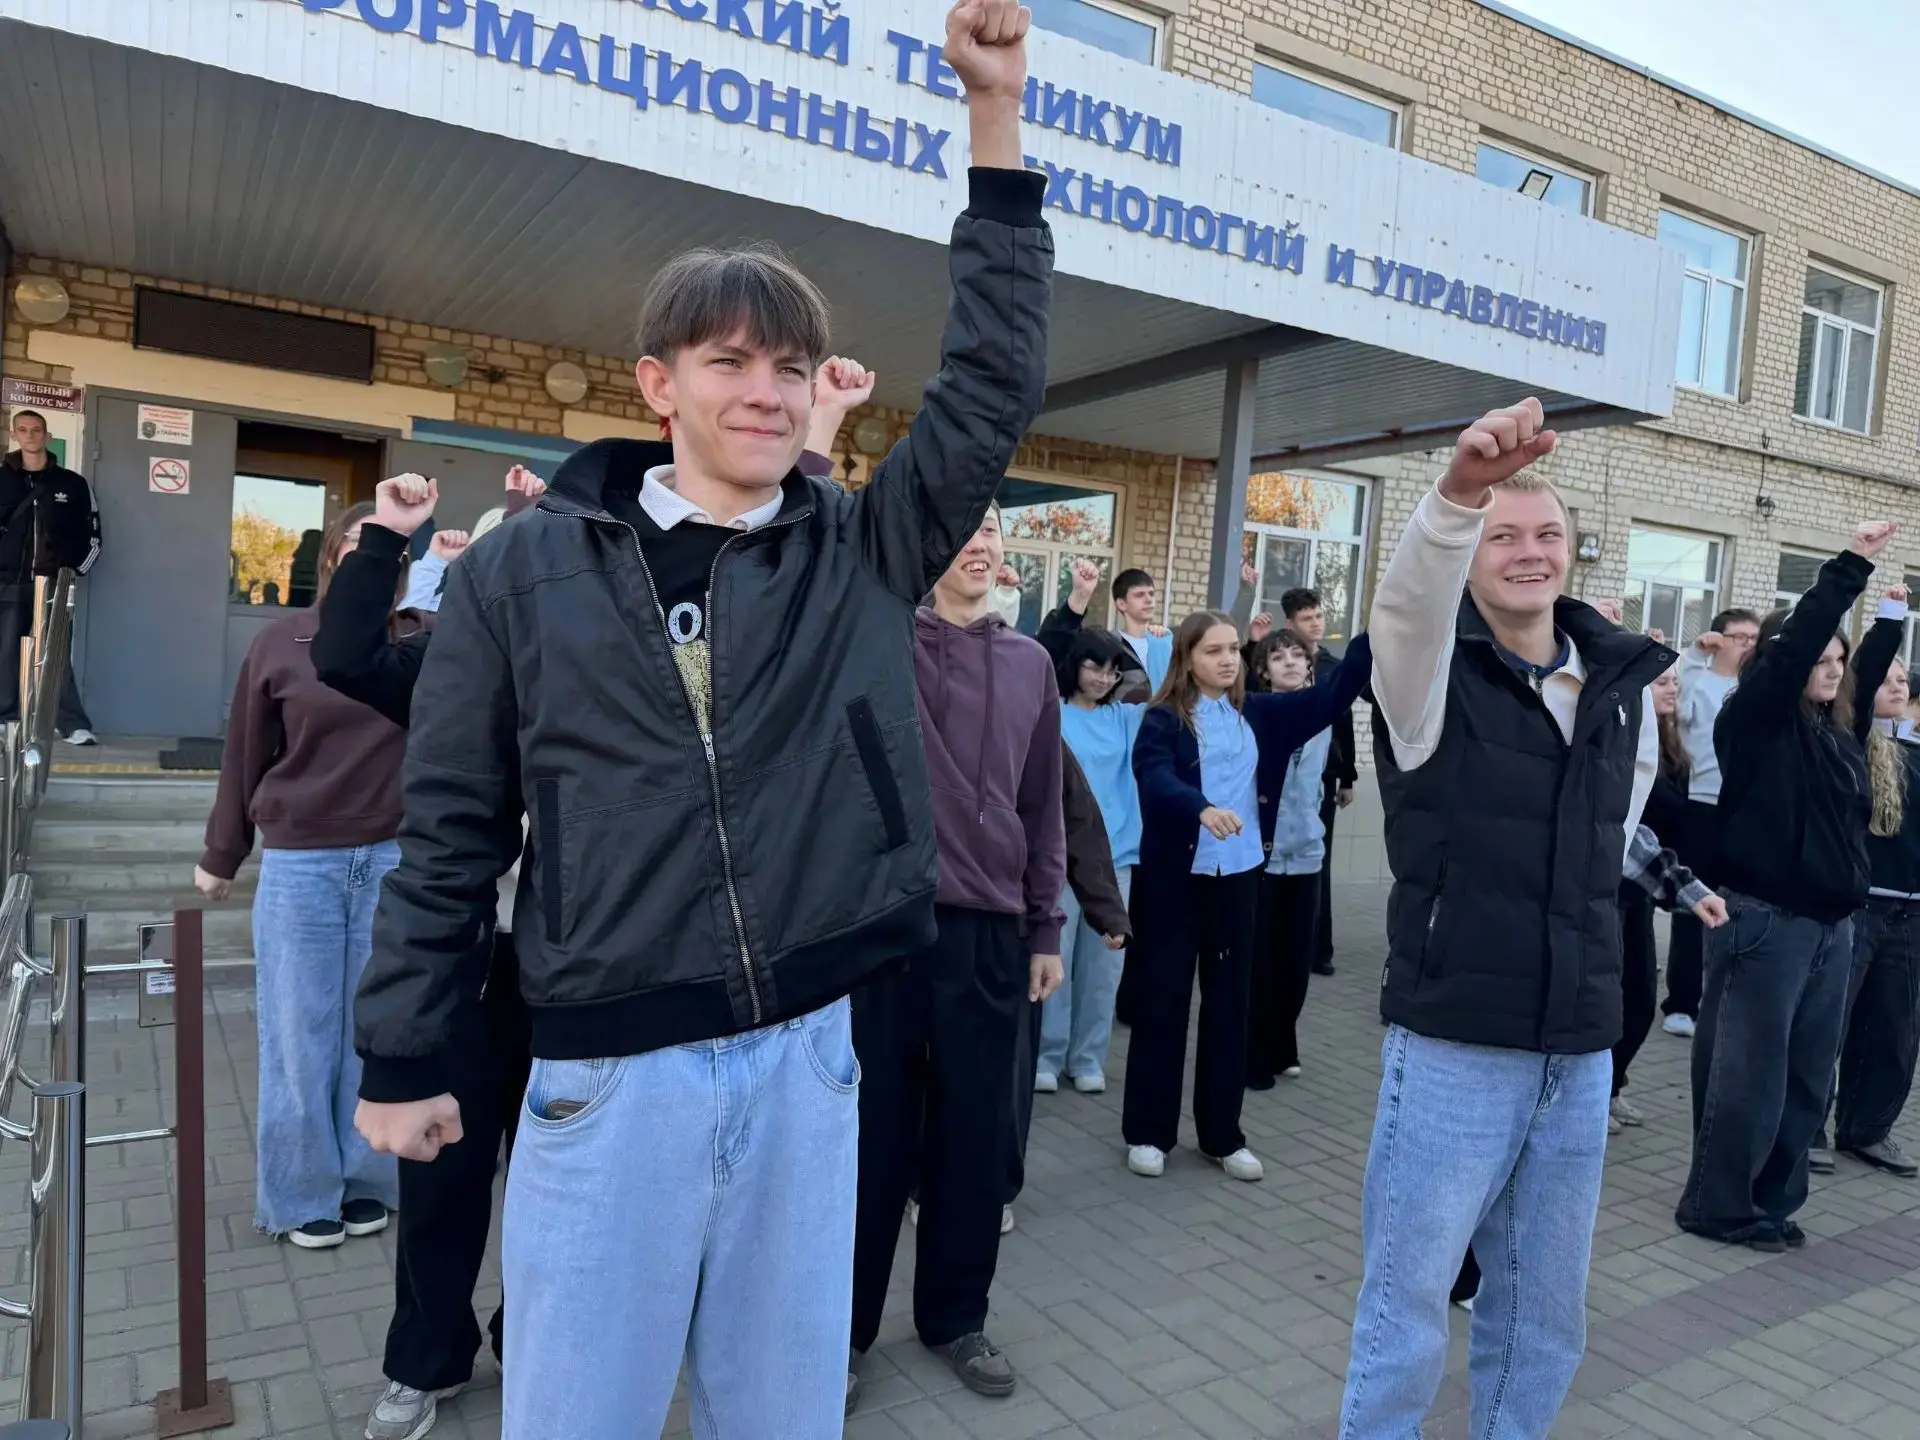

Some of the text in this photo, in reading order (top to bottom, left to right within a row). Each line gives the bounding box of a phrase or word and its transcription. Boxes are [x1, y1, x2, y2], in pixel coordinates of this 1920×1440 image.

[887, 30, 1182, 167] ТЕИКУМ
[300, 0, 1606, 355] ОРМАЦИОННЫХ ХНОЛОГИЙ И УПРАВЛЕНИЯ
[10, 393, 75, 409] КОРПУС №2
[15, 382, 71, 397] УЧЕБНЫЙ
